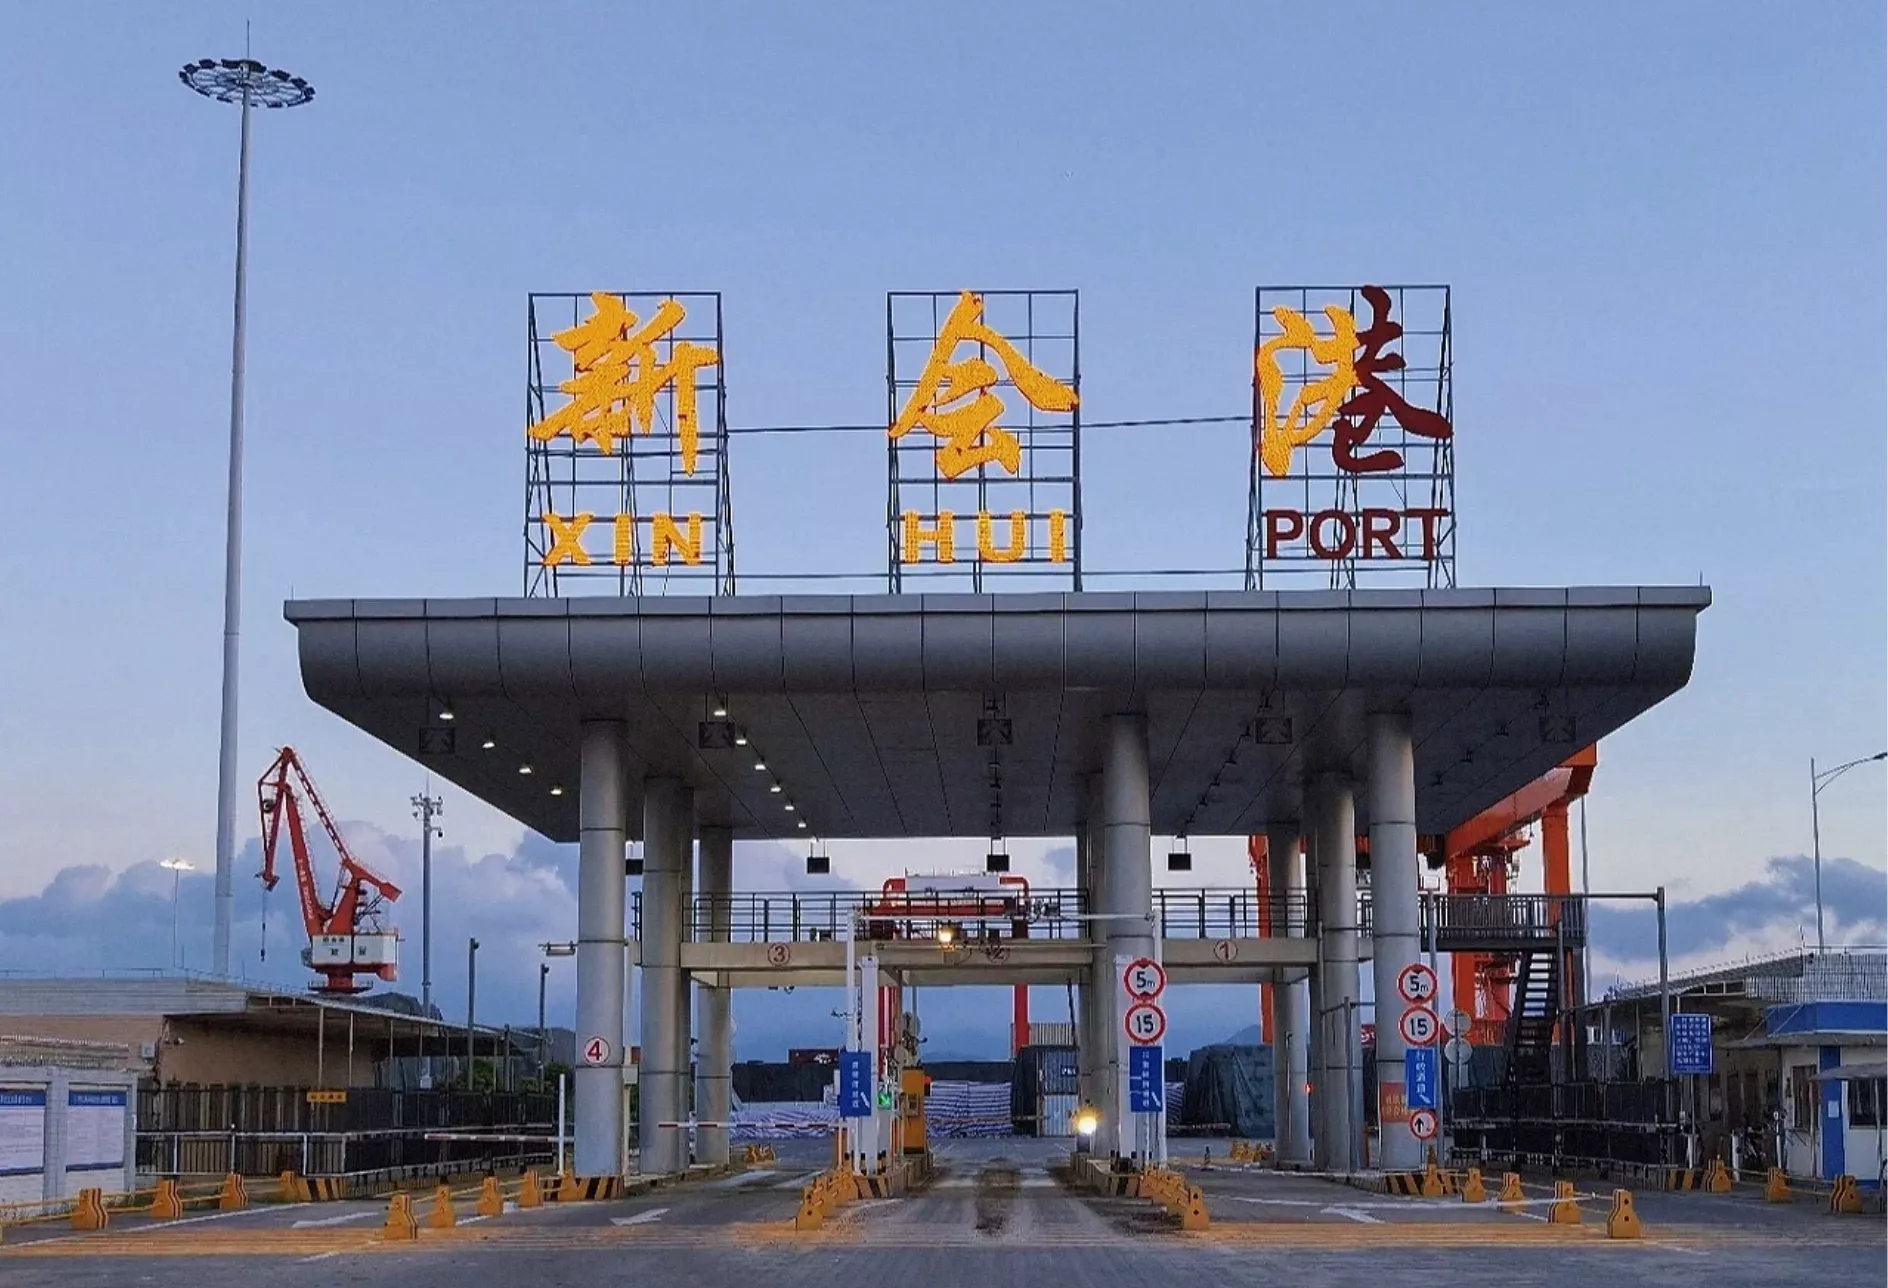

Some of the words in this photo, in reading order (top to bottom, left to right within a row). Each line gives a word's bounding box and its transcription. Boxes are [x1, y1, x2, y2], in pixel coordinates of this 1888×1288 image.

[528, 286, 1453, 479] 新会港
[543, 513, 702, 566] XIN
[904, 510, 1066, 563] HUI
[1265, 508, 1450, 561] PORT
[773, 945, 785, 963] 3
[1219, 941, 1229, 960] 1
[1136, 970, 1155, 988] 5m
[1409, 974, 1429, 993] 5m
[1136, 1014, 1154, 1034] 15
[1410, 1017, 1428, 1036] 15
[587, 1040, 602, 1061] 4
